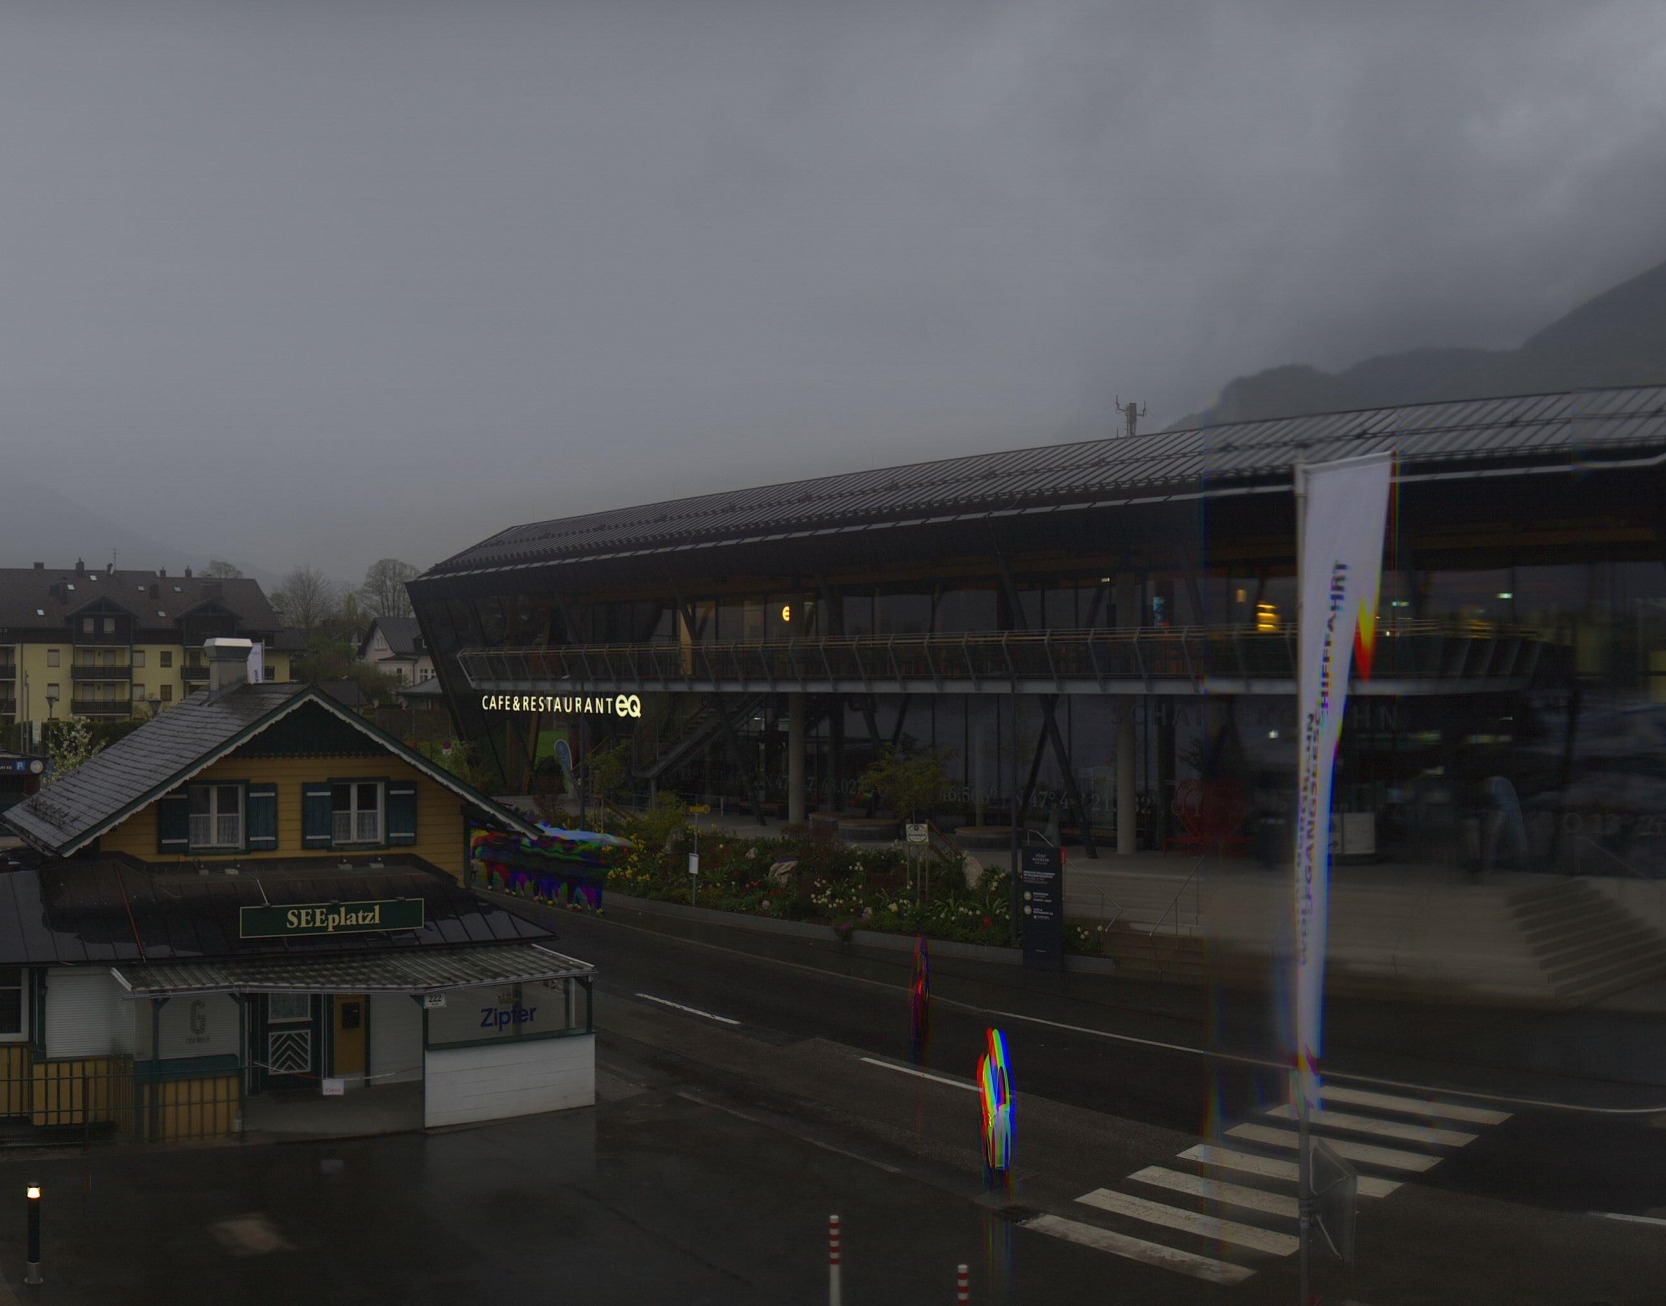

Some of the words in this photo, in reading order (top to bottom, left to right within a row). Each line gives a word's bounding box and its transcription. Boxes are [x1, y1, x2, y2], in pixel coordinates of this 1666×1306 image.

[286, 905, 380, 932] SEEplatzl
[428, 995, 442, 1003] 222
[480, 1004, 537, 1032] Zipfer
